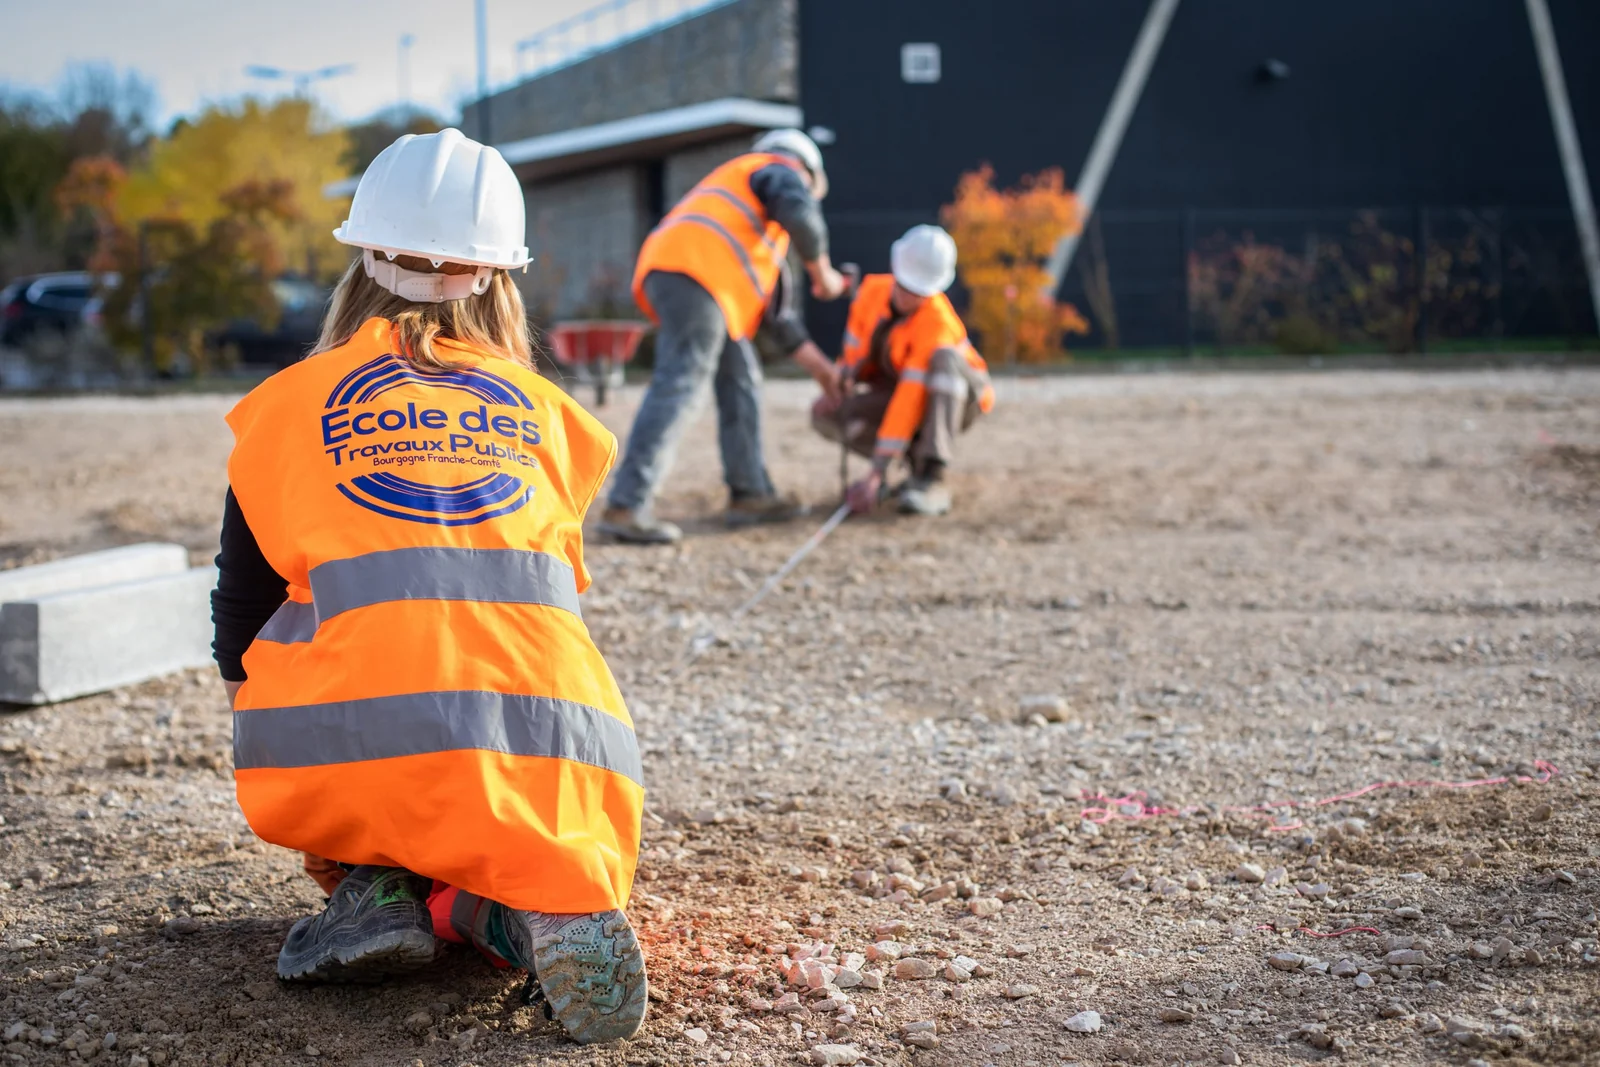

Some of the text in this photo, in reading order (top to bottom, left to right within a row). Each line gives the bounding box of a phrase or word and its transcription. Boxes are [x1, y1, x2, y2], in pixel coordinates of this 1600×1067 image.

[321, 402, 542, 446] Ecole des
[325, 433, 540, 470] Travaux Publics
[373, 453, 502, 469] Bourgogne Franche-Comté
